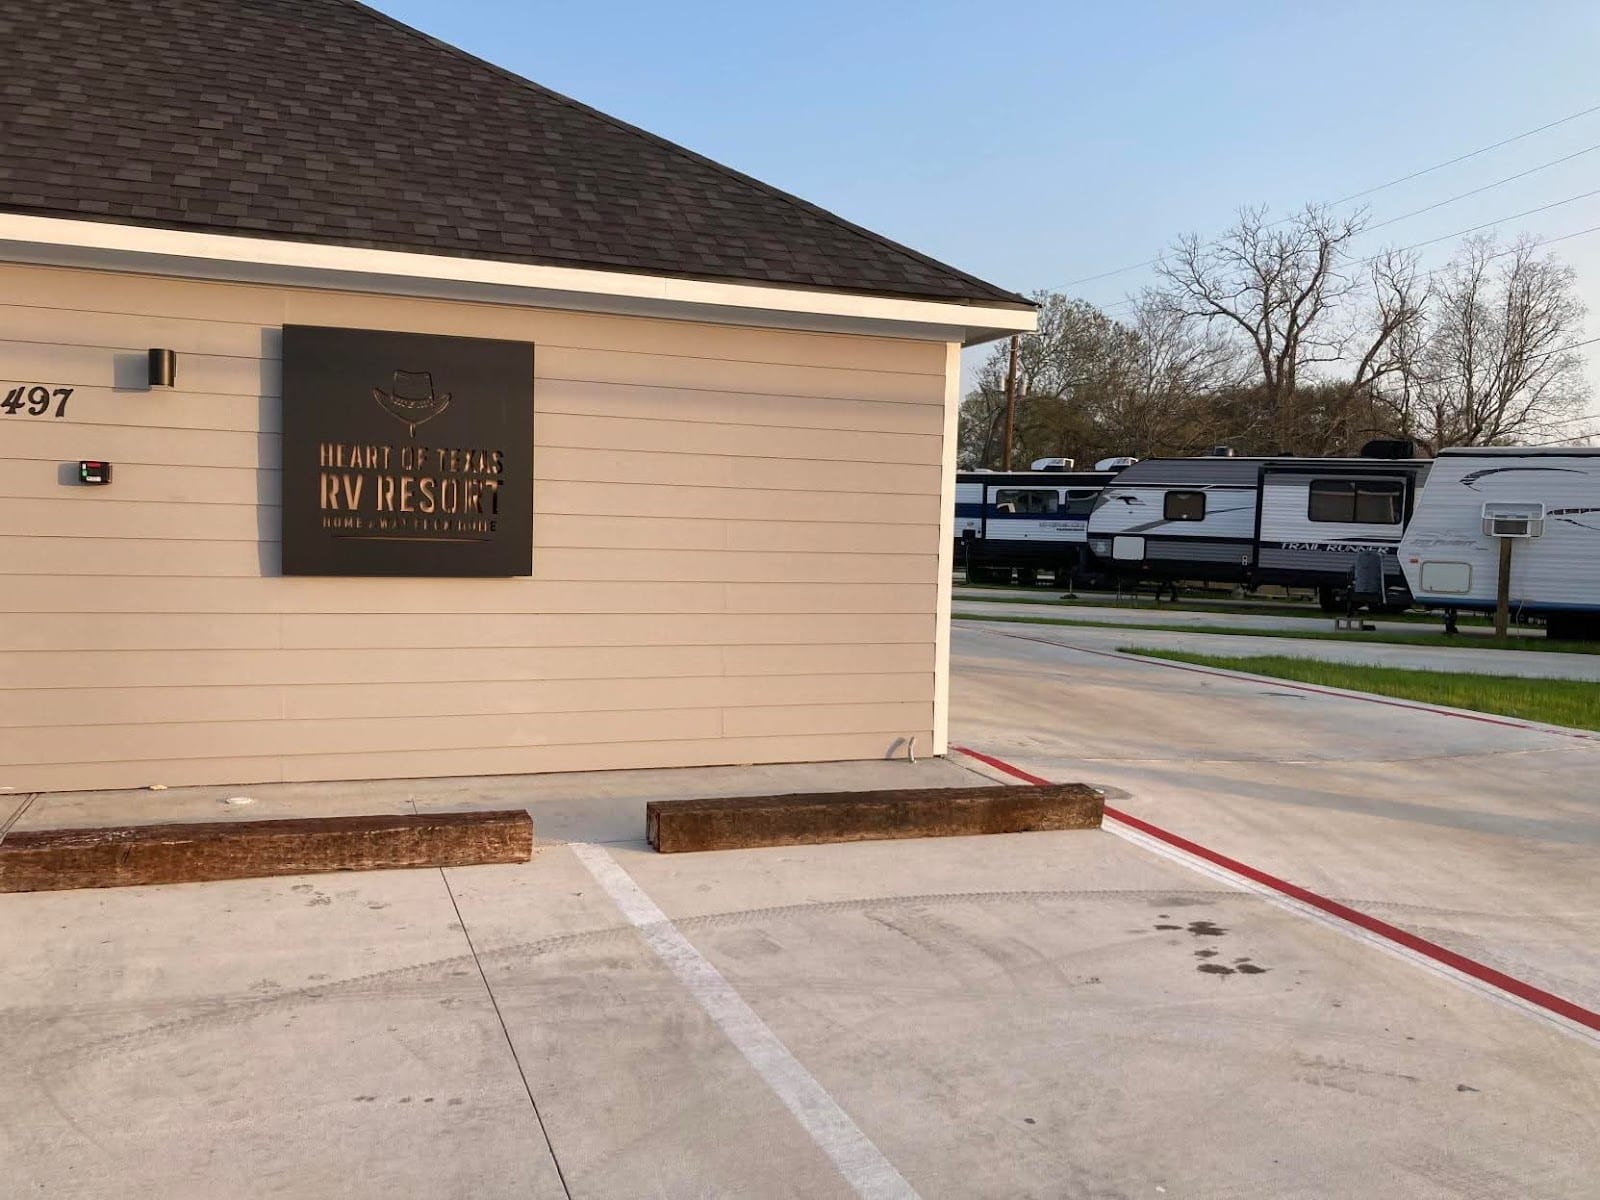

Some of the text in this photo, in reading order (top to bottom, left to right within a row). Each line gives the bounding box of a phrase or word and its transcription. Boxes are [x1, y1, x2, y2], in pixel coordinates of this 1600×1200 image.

[0, 386, 74, 418] 497
[320, 442, 504, 474] HEART OF TEXAS
[320, 472, 504, 515] RV RESORT
[322, 516, 364, 529] HOME
[1281, 542, 1389, 554] TRAIL RUNNER
